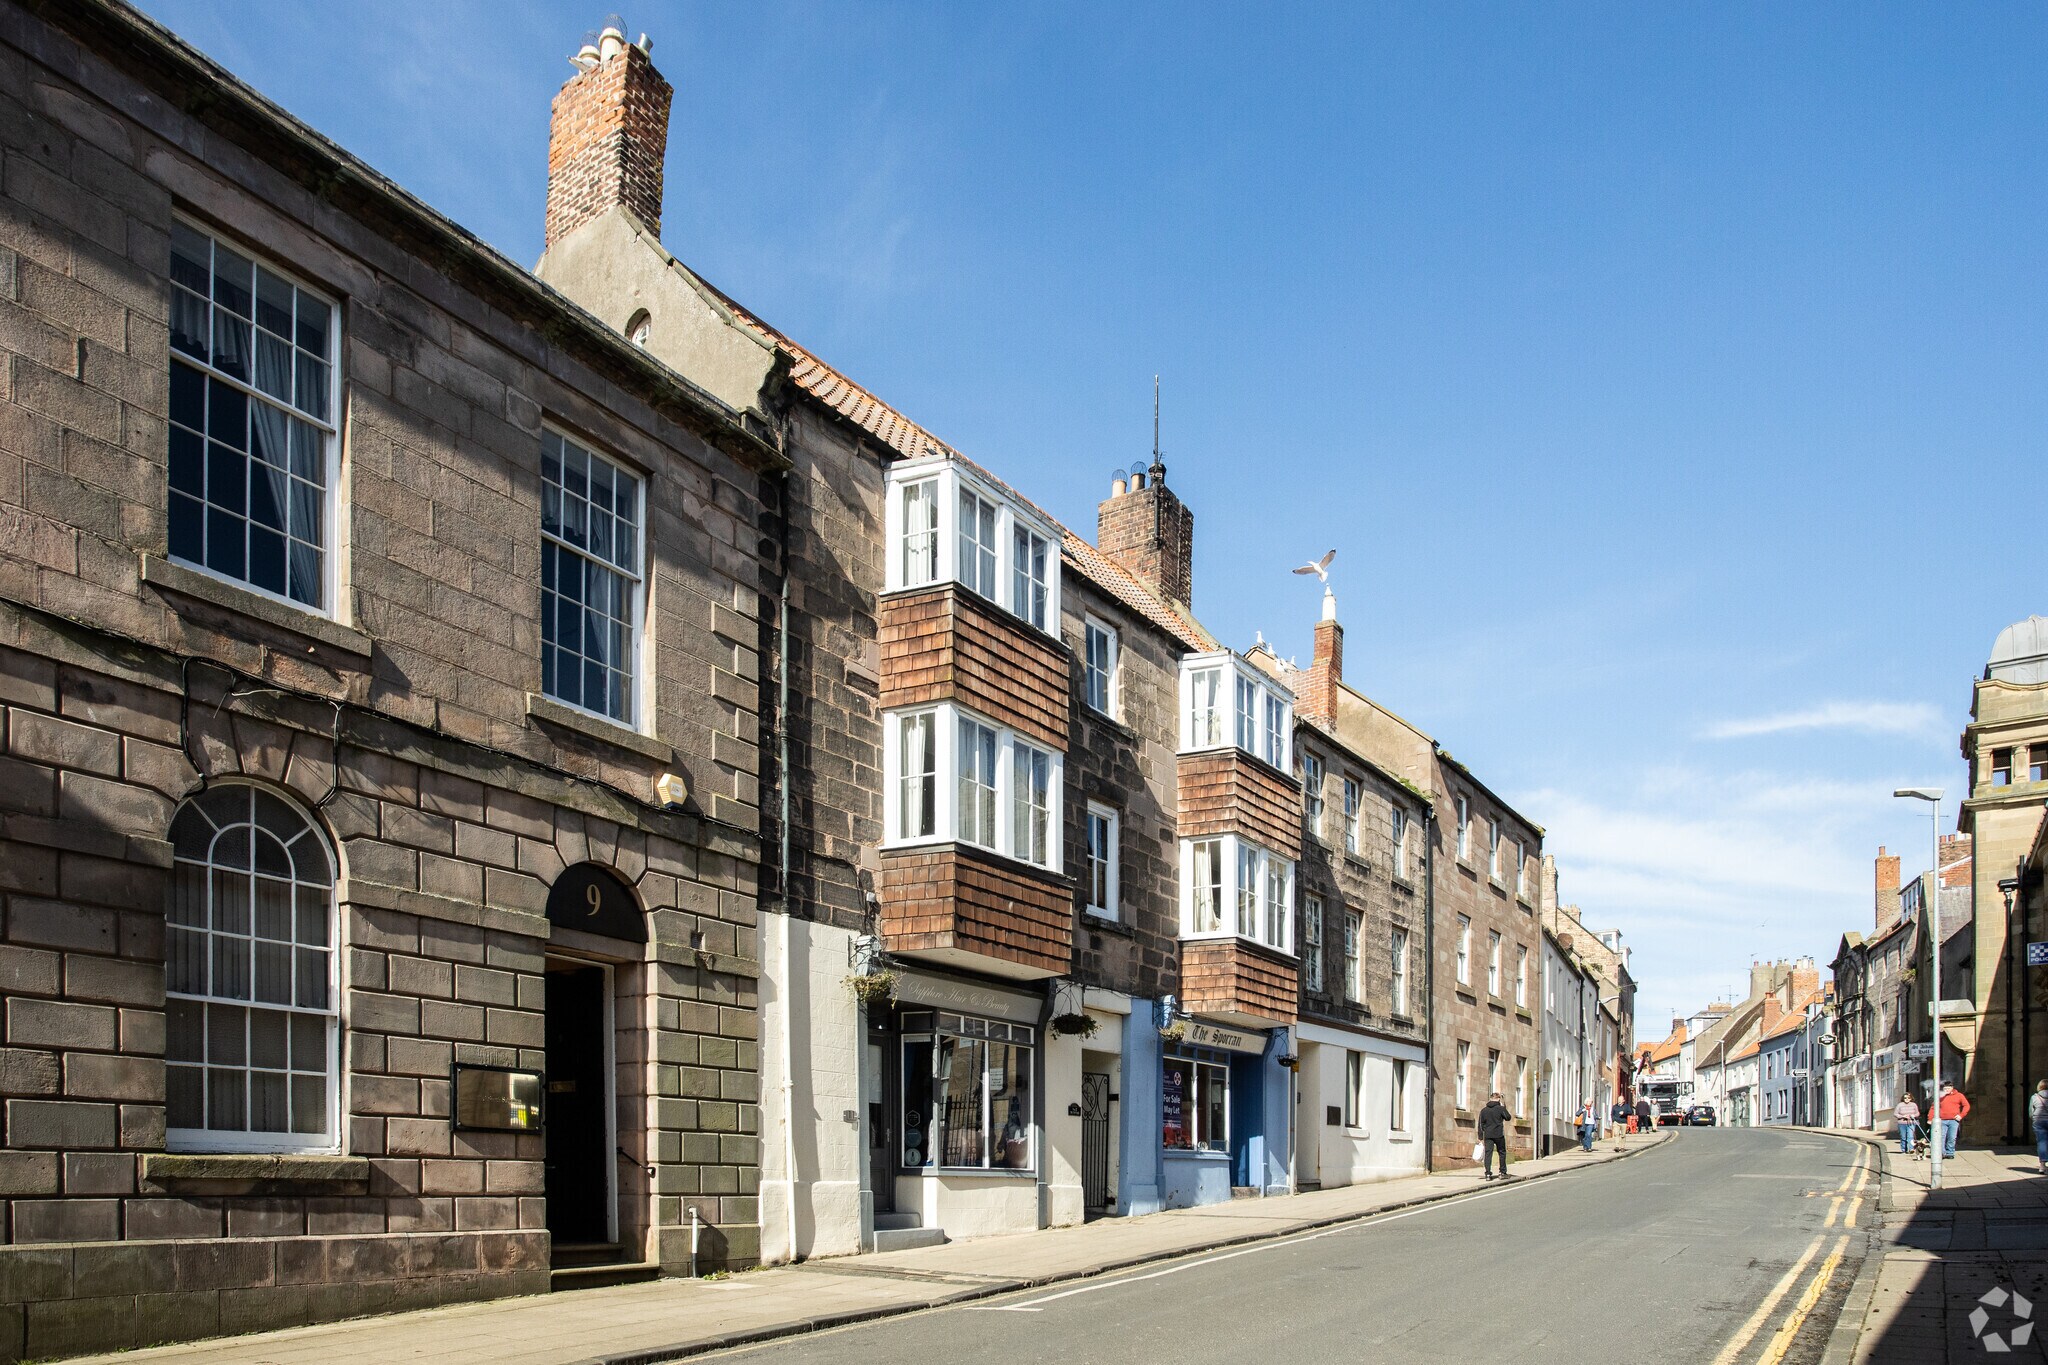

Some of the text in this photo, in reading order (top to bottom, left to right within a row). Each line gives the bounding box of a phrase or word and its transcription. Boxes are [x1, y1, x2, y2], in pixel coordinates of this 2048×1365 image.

[586, 884, 601, 915] 9
[944, 987, 967, 1003] Hair
[981, 993, 1010, 1016] Beauty
[1192, 1024, 1242, 1046] The Sporran
[1164, 1105, 1172, 1115] May
[1171, 1094, 1181, 1104] Sale
